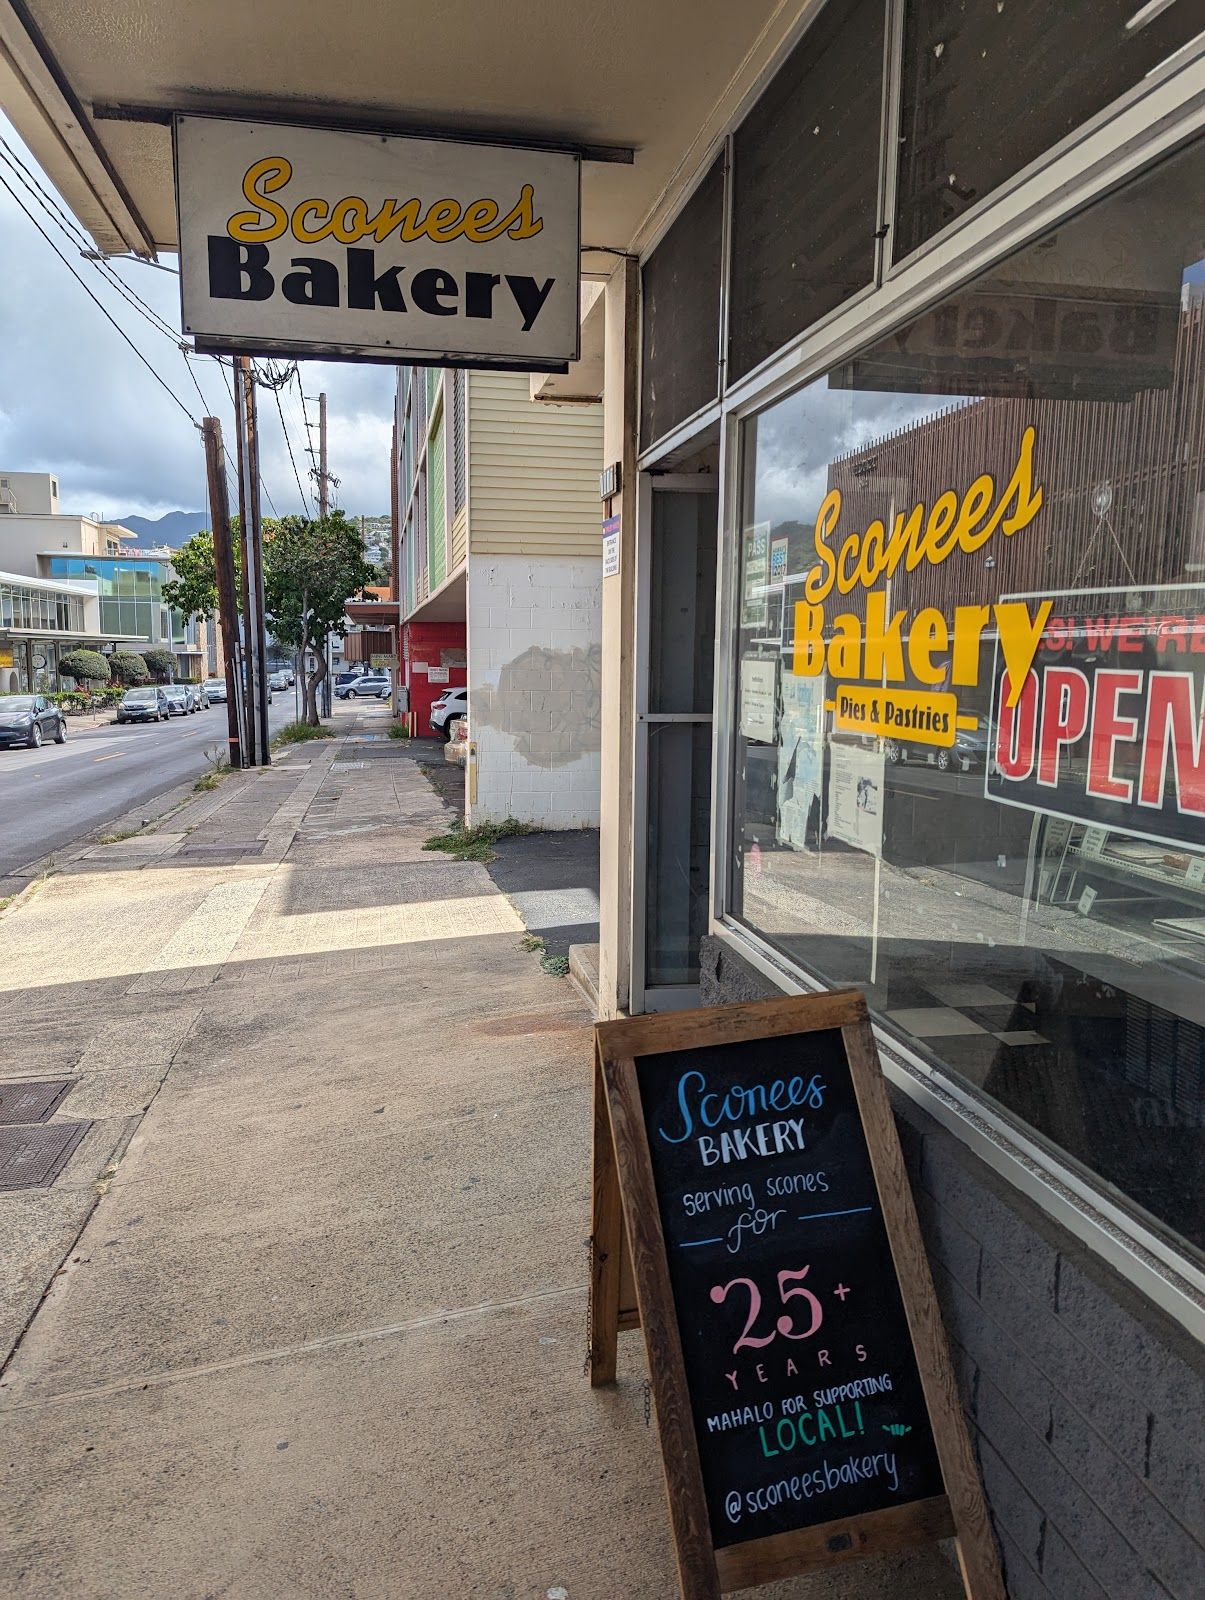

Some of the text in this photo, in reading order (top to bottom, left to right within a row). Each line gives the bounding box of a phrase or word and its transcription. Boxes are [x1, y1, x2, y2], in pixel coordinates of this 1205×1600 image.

[226, 156, 543, 244] Sconees
[207, 235, 556, 332] Bakery
[805, 425, 1044, 604] Sconees
[748, 539, 766, 558] PASS
[792, 591, 1054, 708] Bakery
[841, 696, 949, 733] Pies & Pastries
[995, 665, 1205, 815] OPEN
[659, 1070, 827, 1143] Sconees
[696, 1118, 805, 1167] BAKERY
[683, 1171, 829, 1216] serving scones
[726, 1208, 787, 1254] for
[706, 1373, 893, 1432] MAHALO FOR SUPPORTING
[759, 1400, 865, 1457] LOCAL!
[724, 1452, 900, 1523] @sconeesbakery
